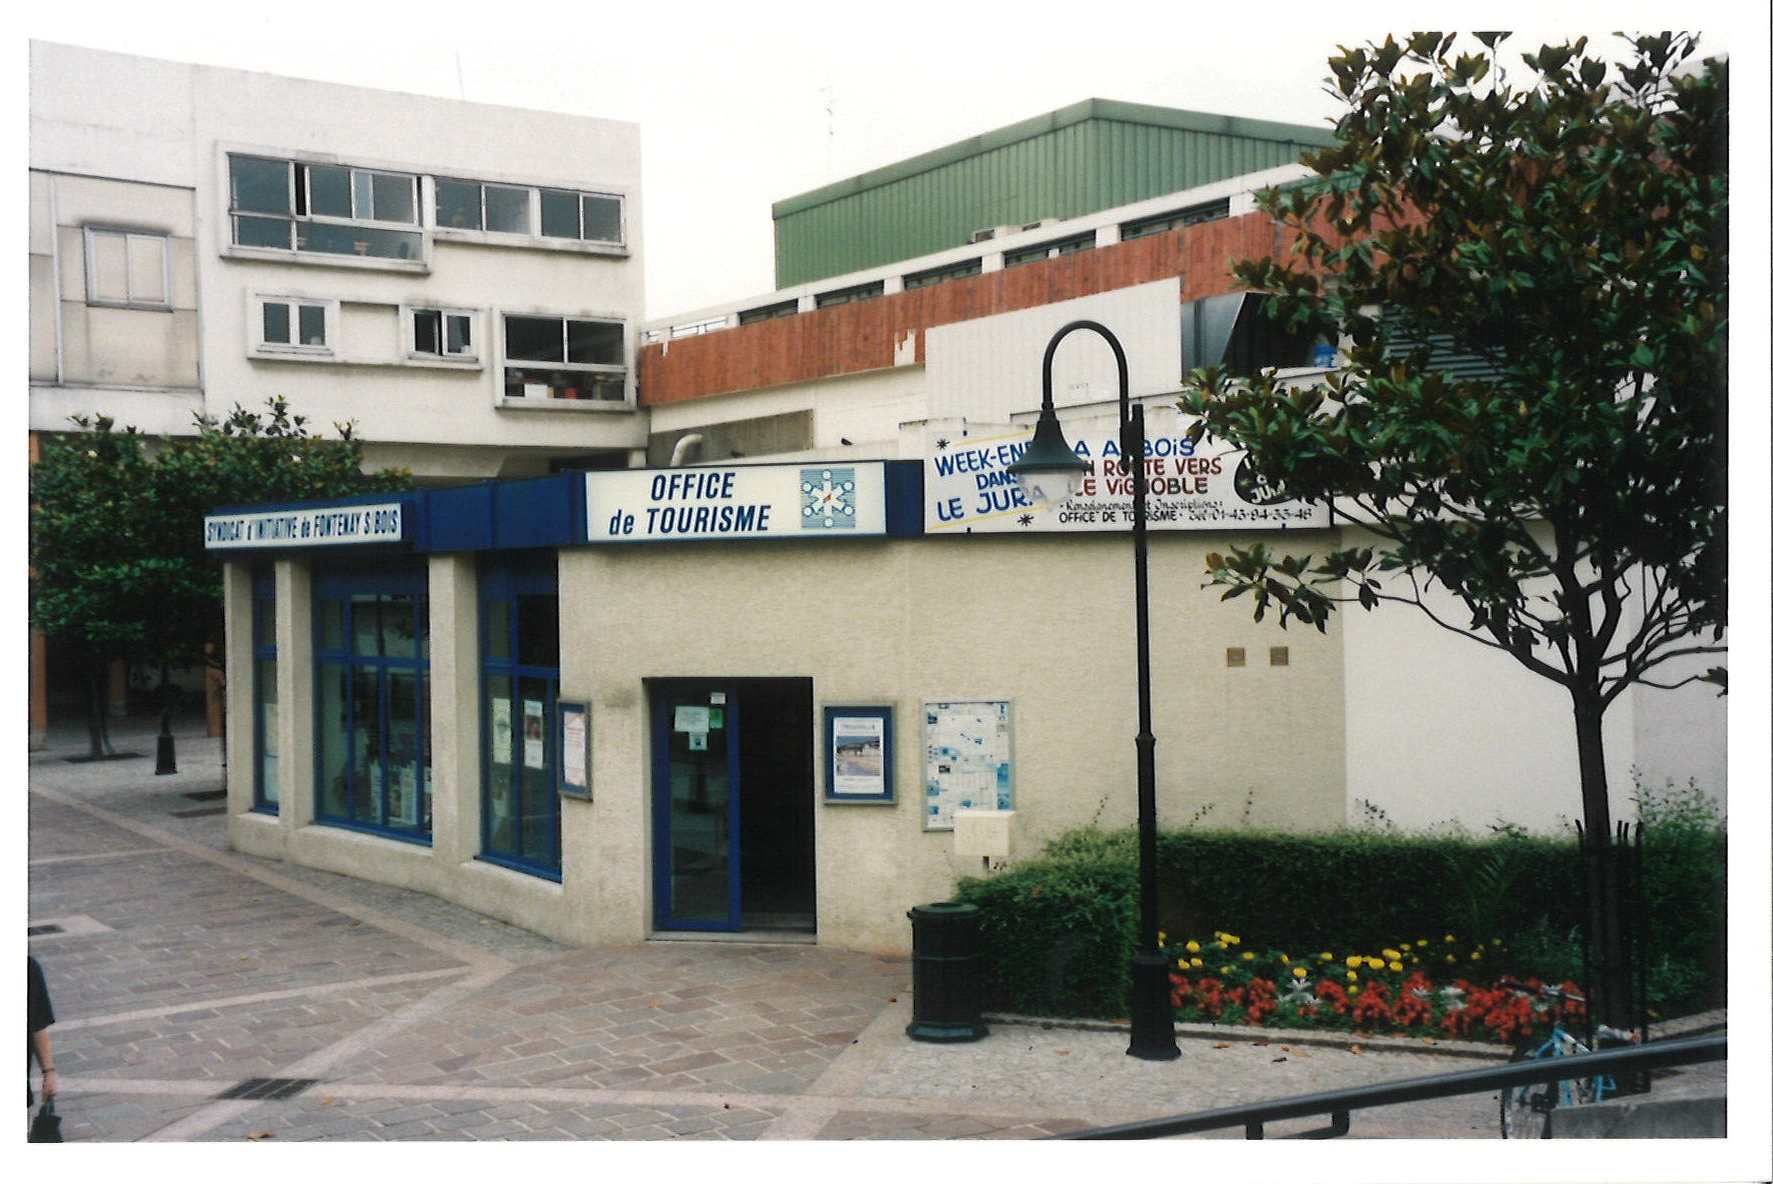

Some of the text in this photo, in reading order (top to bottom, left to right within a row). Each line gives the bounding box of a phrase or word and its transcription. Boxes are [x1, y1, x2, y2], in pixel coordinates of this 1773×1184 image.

[1102, 437, 1195, 458] ABOiS
[1103, 458, 1165, 477] ROTE
[1175, 457, 1222, 476] VERS
[651, 472, 735, 501] OFFICE
[609, 504, 771, 535] de TOURISME
[937, 497, 964, 522] LE
[1102, 511, 1117, 523] DE
[207, 519, 245, 541] SYNDICAT
[314, 512, 362, 537] FONTENAY
